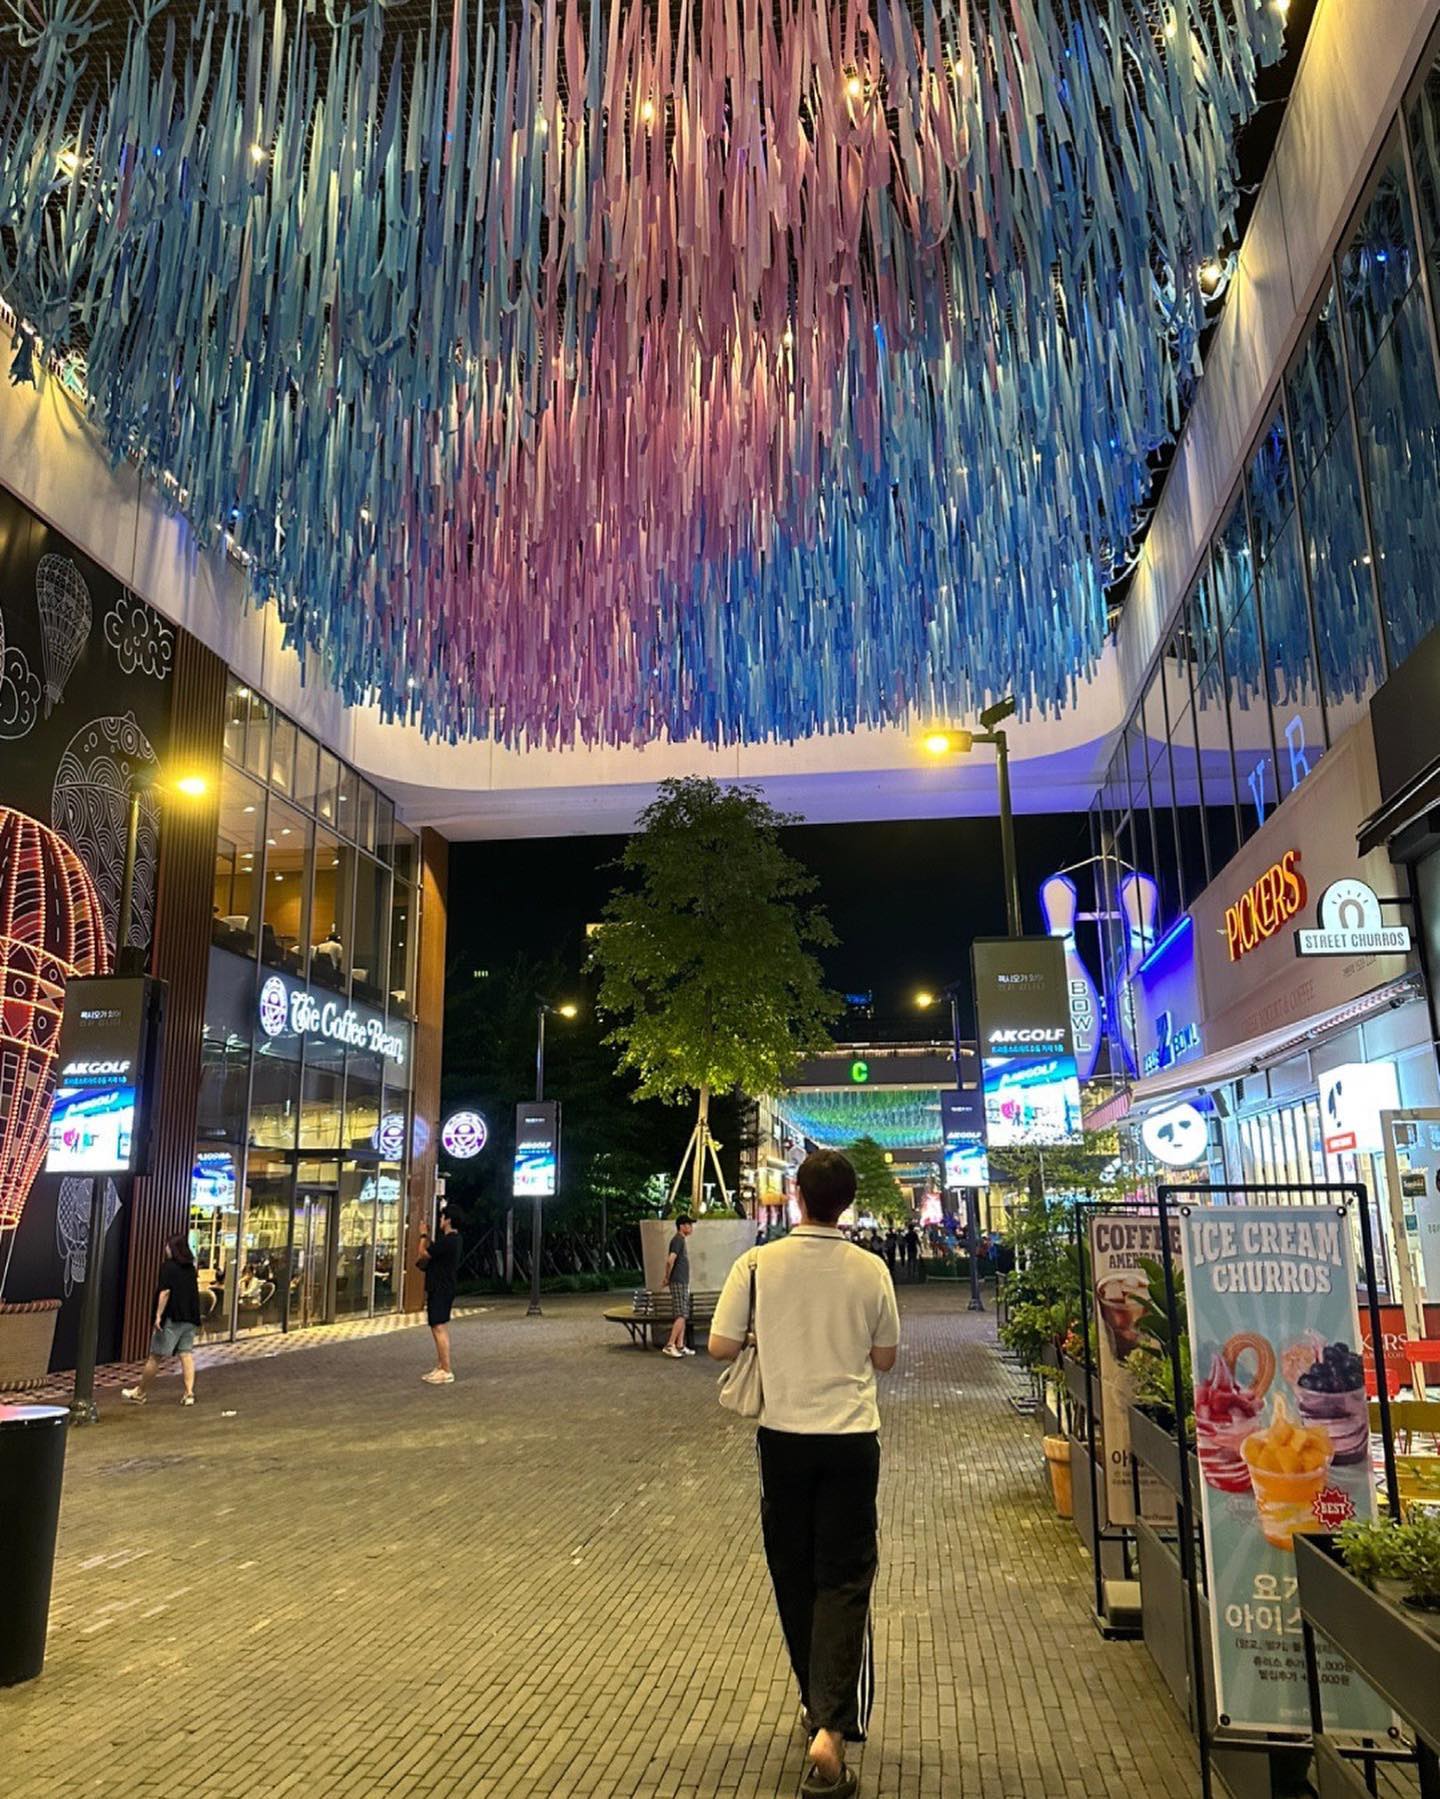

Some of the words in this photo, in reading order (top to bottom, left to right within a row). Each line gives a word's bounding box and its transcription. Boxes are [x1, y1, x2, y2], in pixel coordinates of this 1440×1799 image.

[1224, 847, 1306, 963] PICKERS
[1304, 934, 1348, 949] STREET
[1351, 931, 1405, 948] CHURROS
[290, 991, 320, 1034] The
[321, 1002, 367, 1047] Coffee
[367, 1019, 404, 1064] Bean
[1069, 979, 1093, 1053] BOWL
[850, 1061, 869, 1083] C
[1191, 1221, 1238, 1267] ICE
[1243, 1221, 1343, 1267] CREAM
[1212, 1261, 1332, 1295] CHURROS
[1320, 1502, 1347, 1515] BEST
